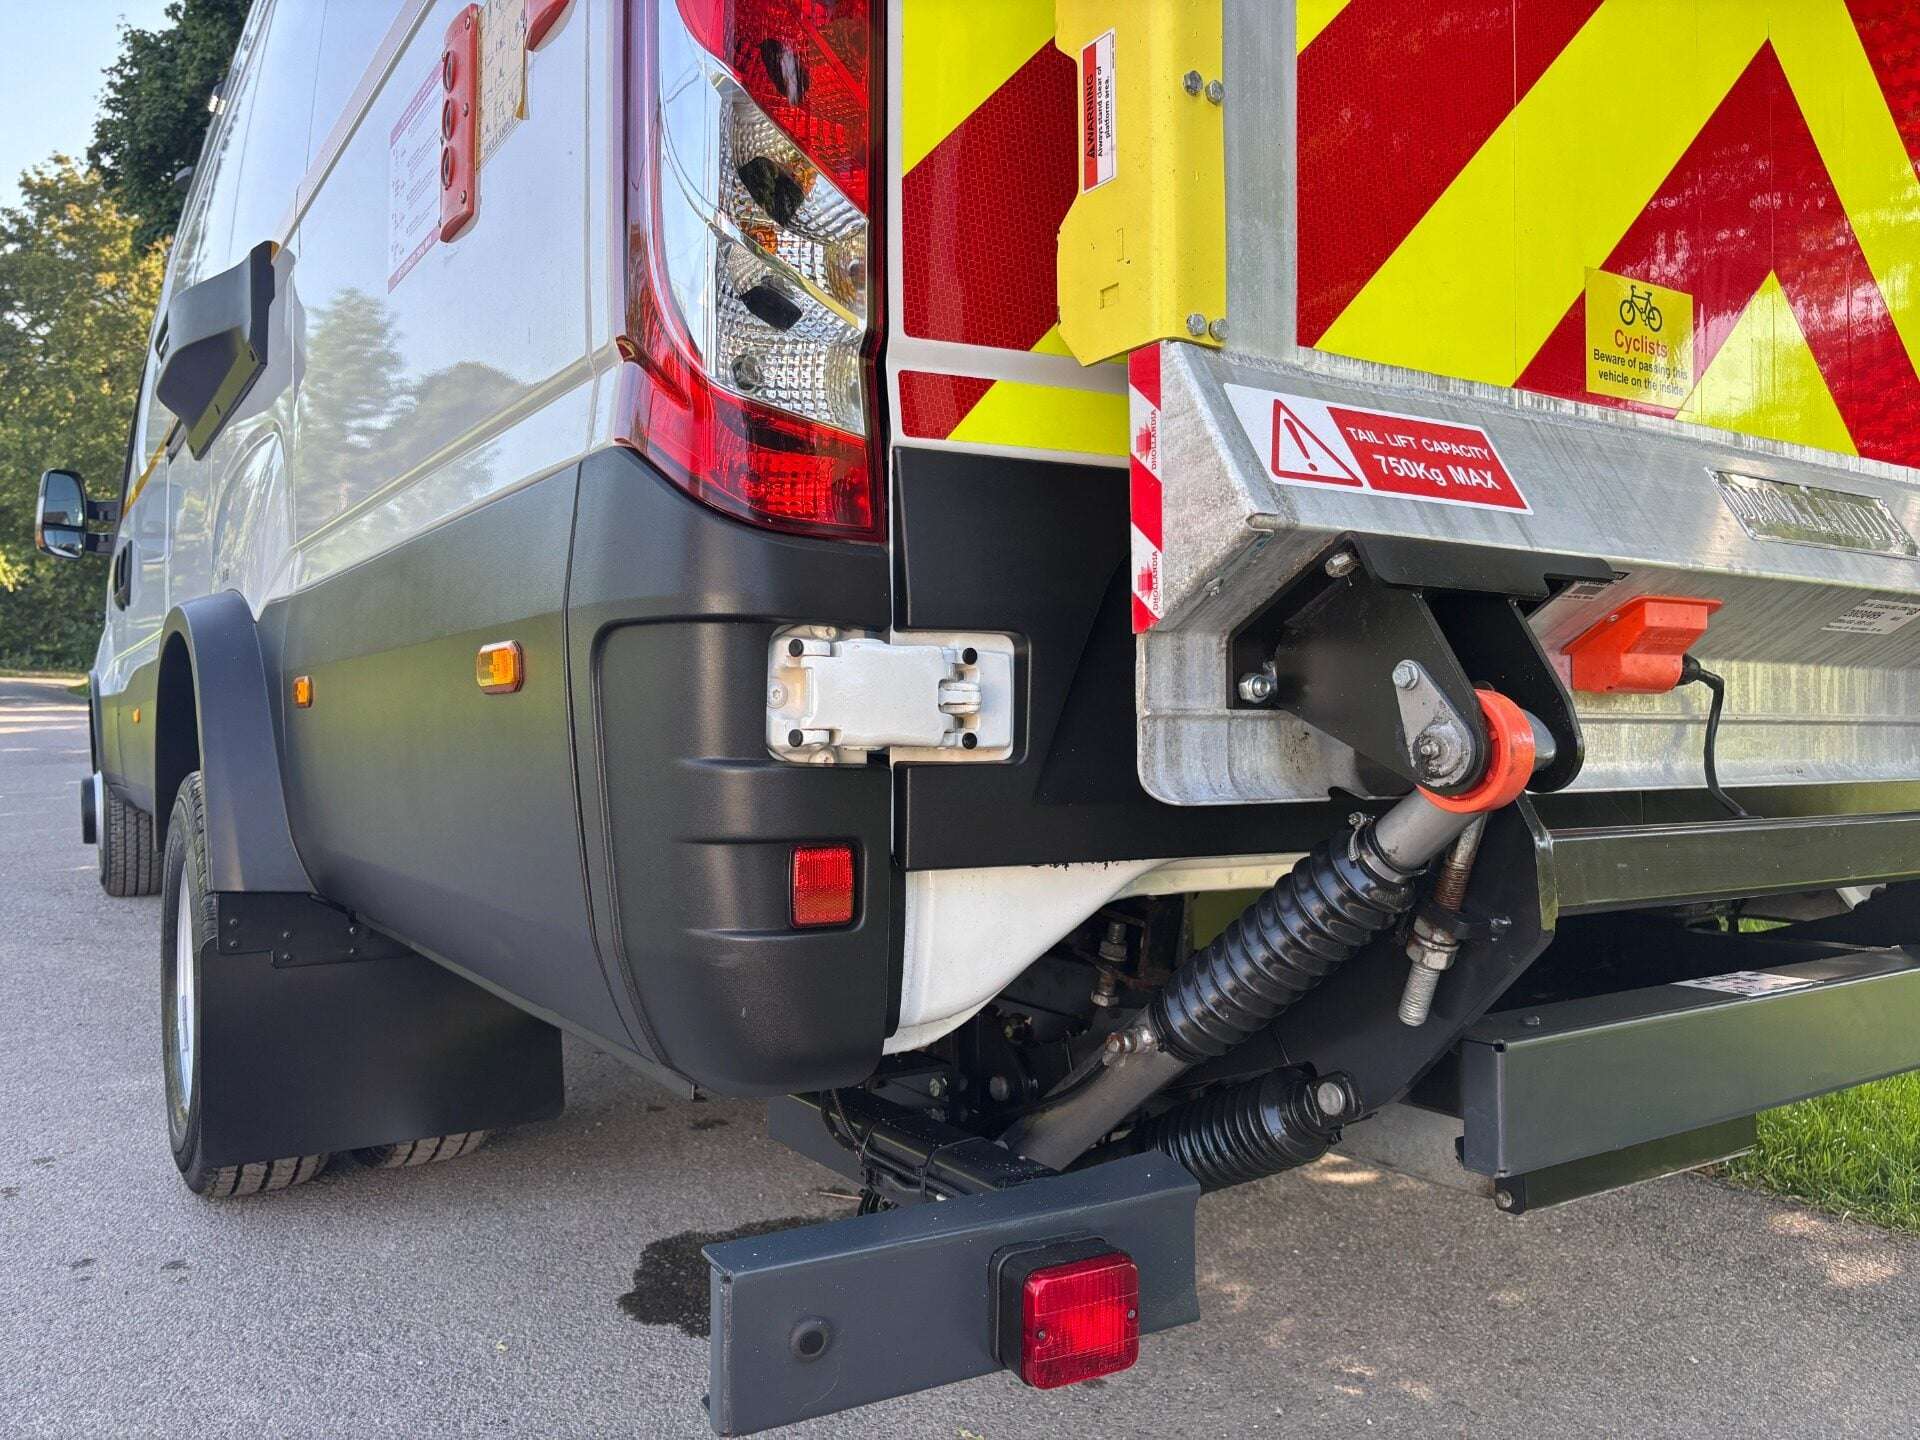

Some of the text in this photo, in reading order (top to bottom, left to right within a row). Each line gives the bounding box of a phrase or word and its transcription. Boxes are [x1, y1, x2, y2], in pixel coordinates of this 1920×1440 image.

[1086, 74, 1094, 146] WARNING
[1614, 329, 1668, 358] Cyclists
[1593, 348, 1688, 380] Beware of passing this
[1598, 369, 1685, 397] vehicle on the inside
[1346, 427, 1491, 461] TAIL LIFT CAPACITY
[1372, 454, 1502, 490] 750Kg MAX
